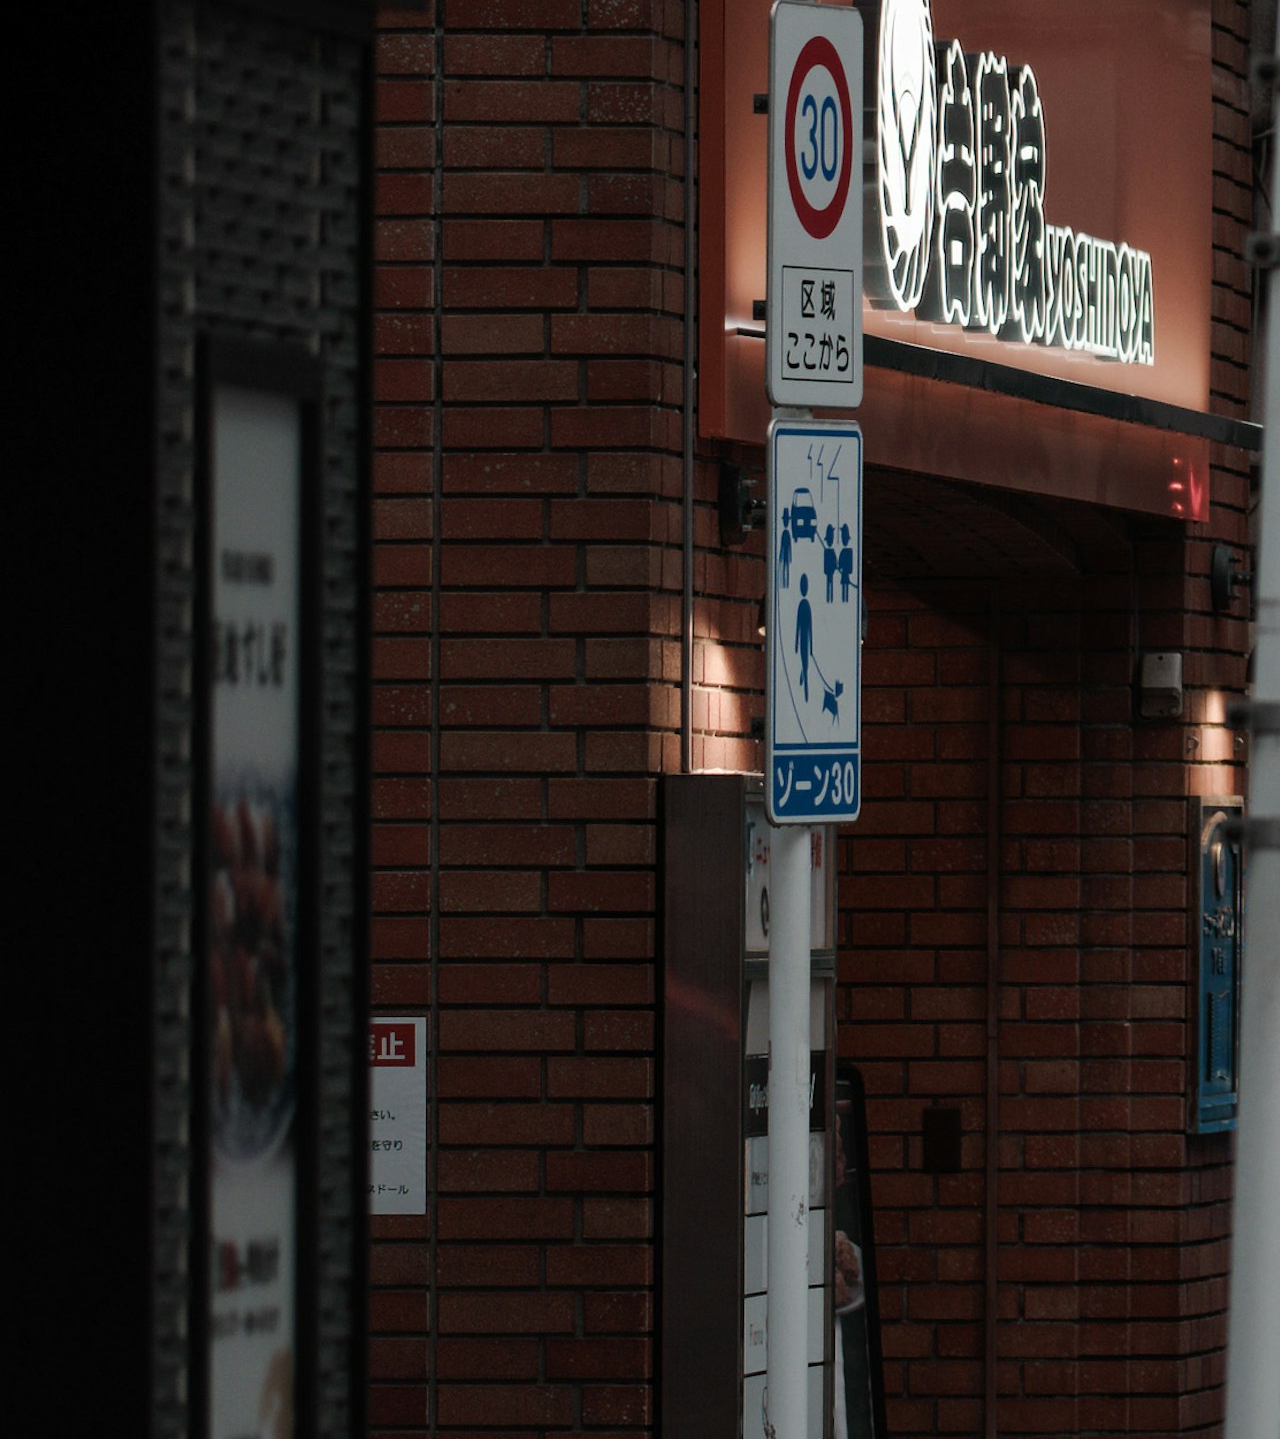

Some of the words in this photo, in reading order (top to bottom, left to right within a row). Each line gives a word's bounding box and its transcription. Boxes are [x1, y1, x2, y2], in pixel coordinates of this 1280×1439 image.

[800, 93, 839, 182] 30
[936, 38, 1048, 346] 吉野家
[800, 279, 837, 321] 区域
[786, 331, 849, 373] ここから
[776, 759, 855, 809] ゾーン30
